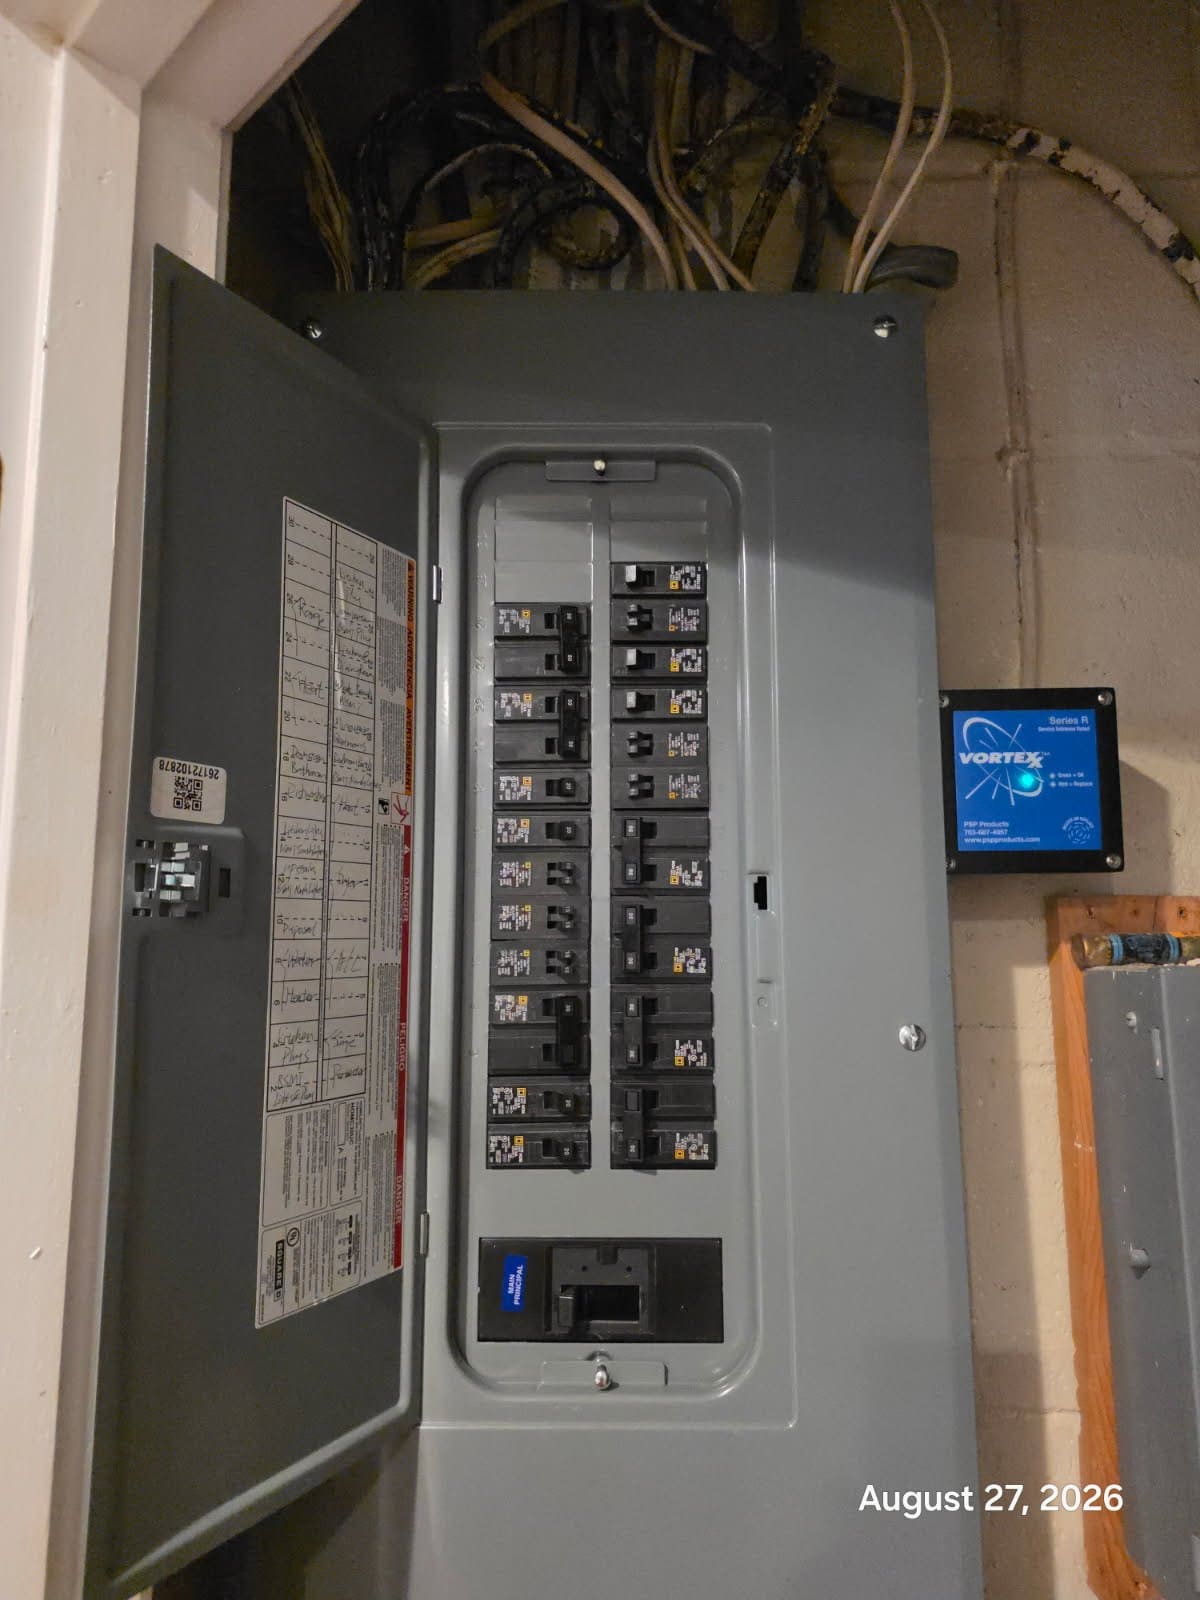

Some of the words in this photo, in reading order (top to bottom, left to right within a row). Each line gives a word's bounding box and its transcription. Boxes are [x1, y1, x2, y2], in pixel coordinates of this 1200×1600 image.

[407, 574, 415, 622] WARNING
[406, 627, 414, 699] ADVERTENCIA
[1049, 716, 1079, 725] Series
[1081, 715, 1089, 725] R
[159, 760, 220, 781] 26172102878
[405, 706, 413, 792] AVERTISSEMENT
[965, 837, 1041, 845] www.pspproducts.com
[402, 876, 410, 923] DANGER
[398, 1021, 407, 1072] PELIGRO
[395, 1175, 404, 1224] DANGER
[275, 1242, 283, 1287] SQUARE
[507, 1273, 516, 1295] MAIN
[513, 1264, 525, 1306] PRINCIPAL
